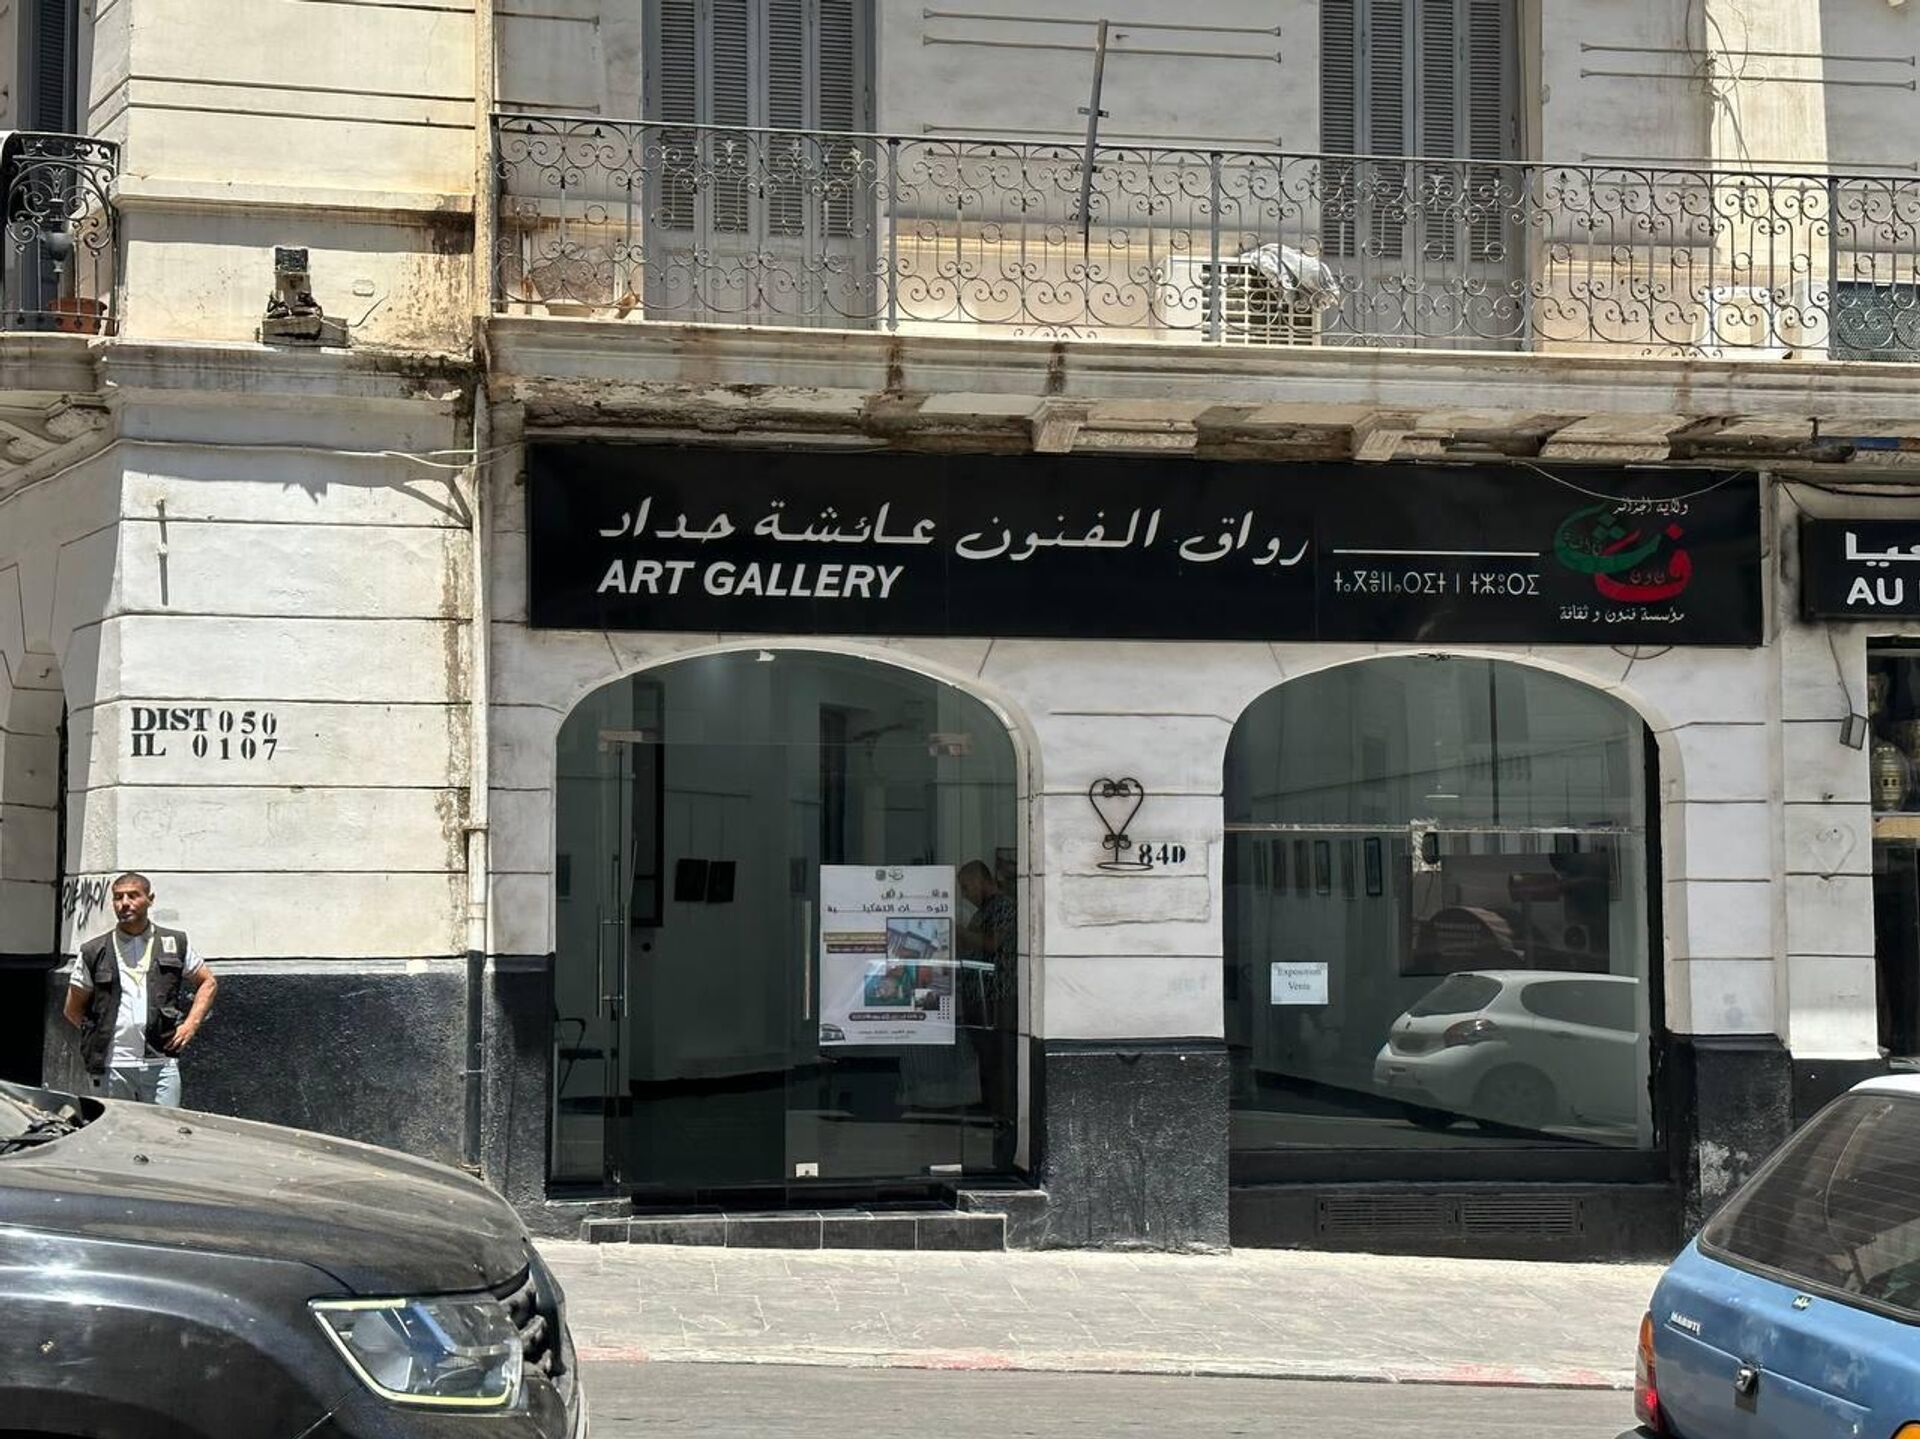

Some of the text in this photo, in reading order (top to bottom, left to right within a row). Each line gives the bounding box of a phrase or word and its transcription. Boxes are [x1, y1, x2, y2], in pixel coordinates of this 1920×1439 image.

[599, 496, 1309, 565] رواق الفنون عائشة حداد
[597, 559, 904, 599] ART GALLERY
[1846, 577, 1903, 606] AU
[1559, 604, 1685, 623] مؤسسة فنون و ثقافة
[131, 707, 277, 735] DIST 050
[131, 733, 277, 760] IL 0107
[1138, 843, 1186, 865] 84D
